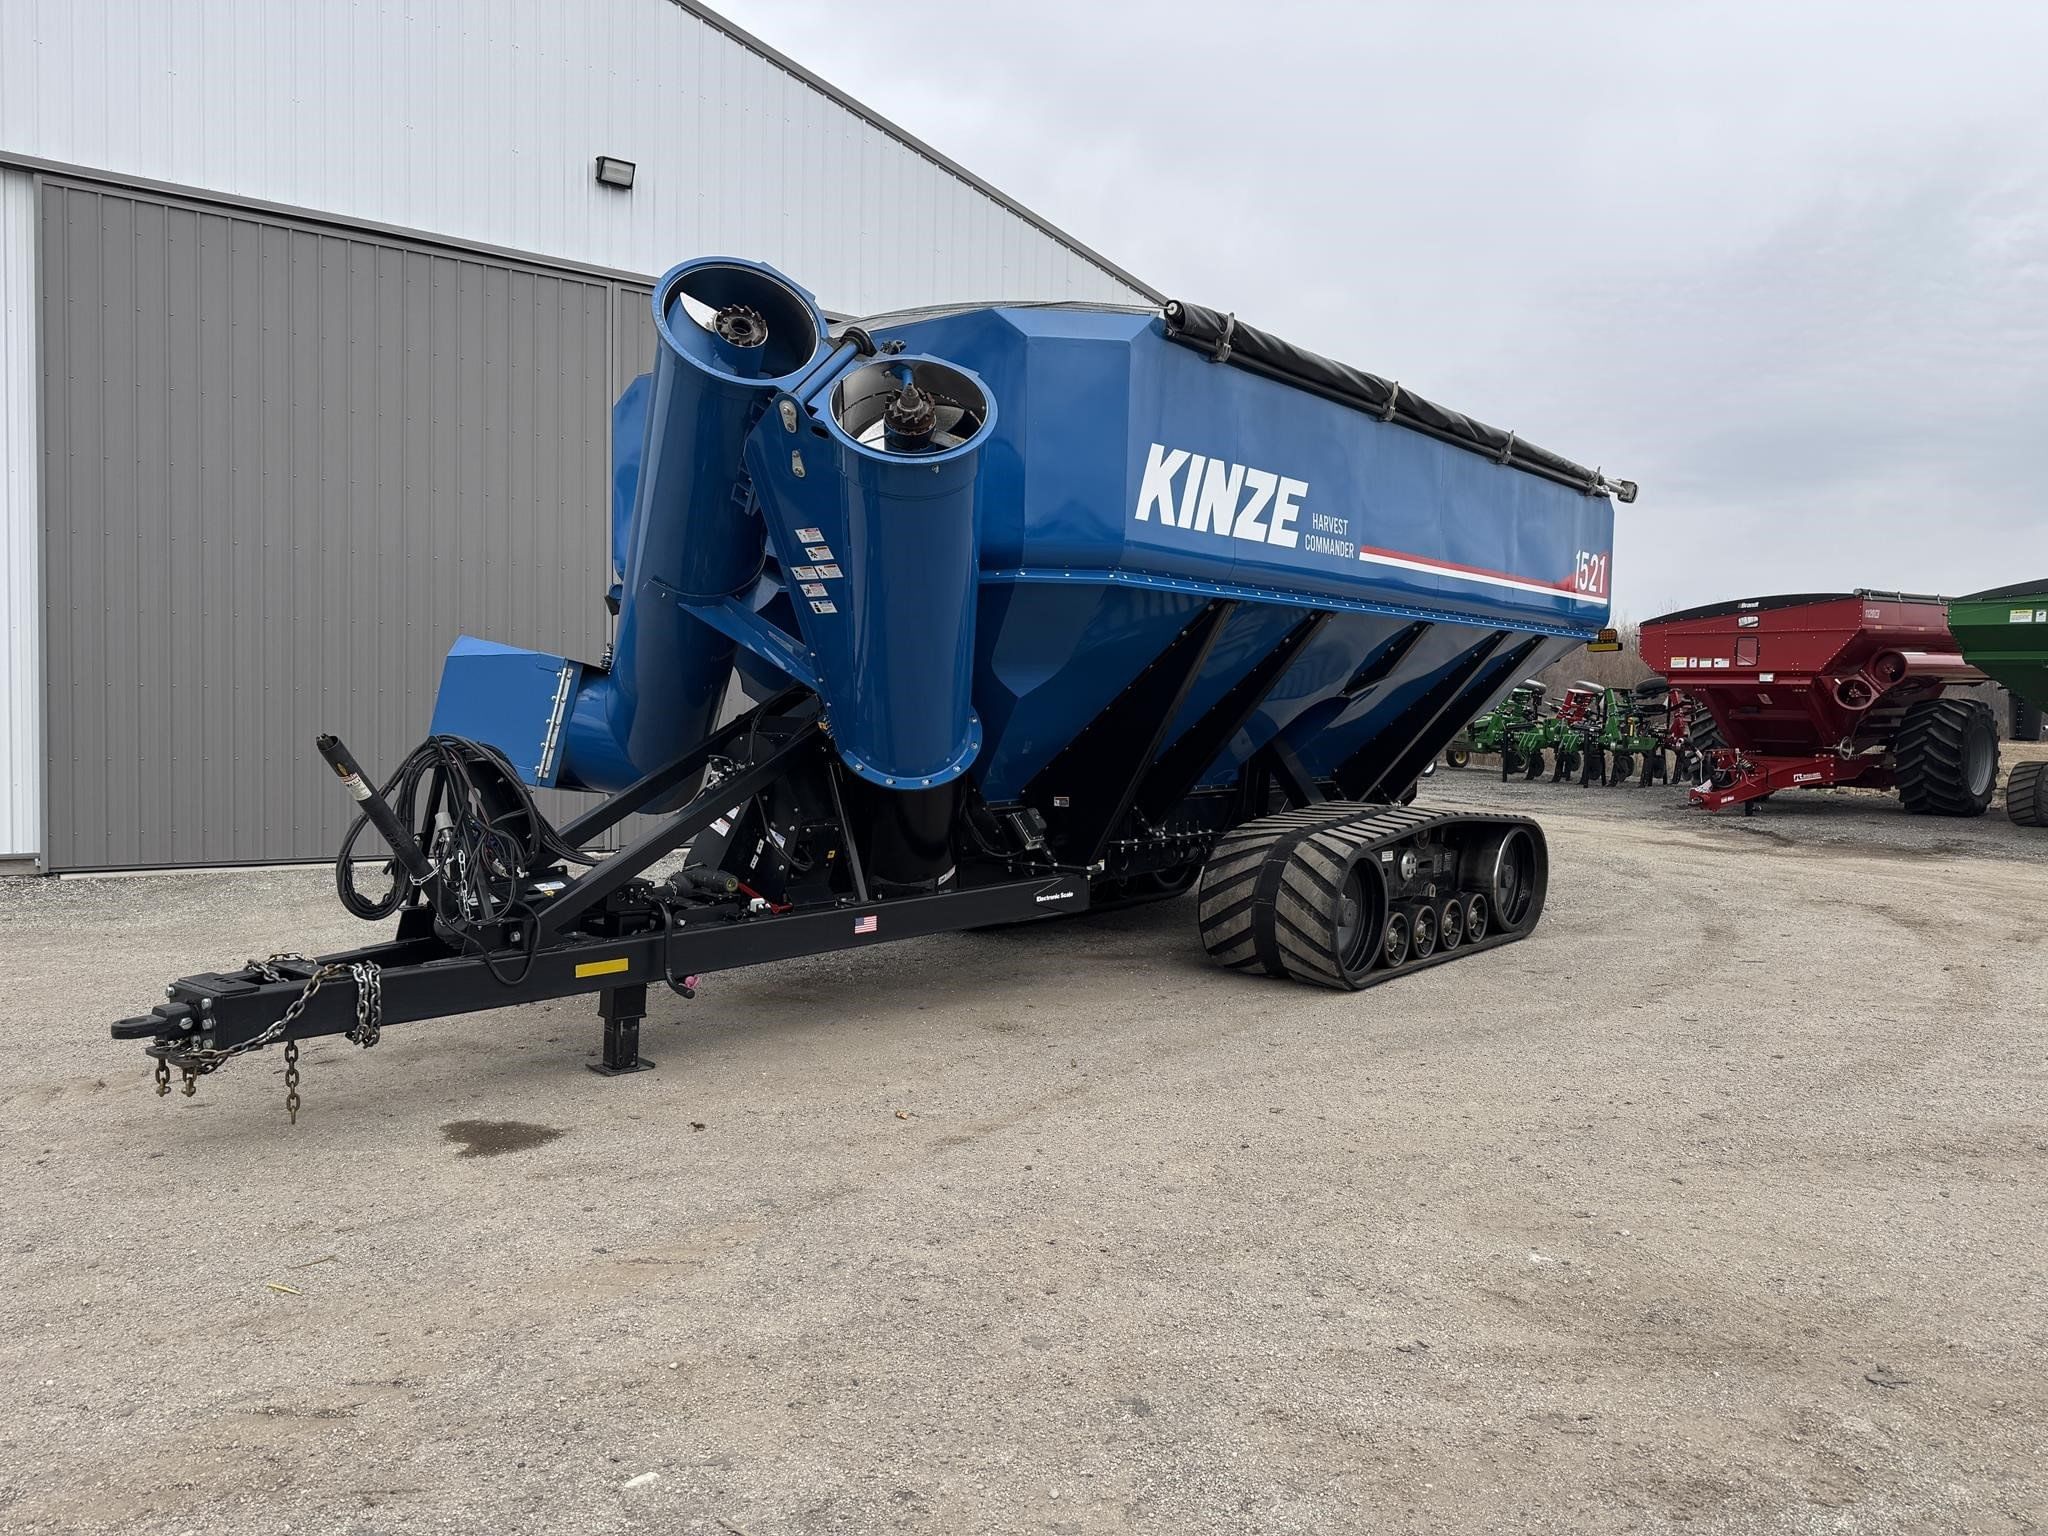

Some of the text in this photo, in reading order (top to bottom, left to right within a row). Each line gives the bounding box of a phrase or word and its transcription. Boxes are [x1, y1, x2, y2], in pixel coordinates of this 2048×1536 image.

[1135, 443, 1309, 549] KINZE
[1312, 512, 1349, 536] HARVEST
[1304, 533, 1355, 559] COMMANDER
[1575, 549, 1606, 594] 1521
